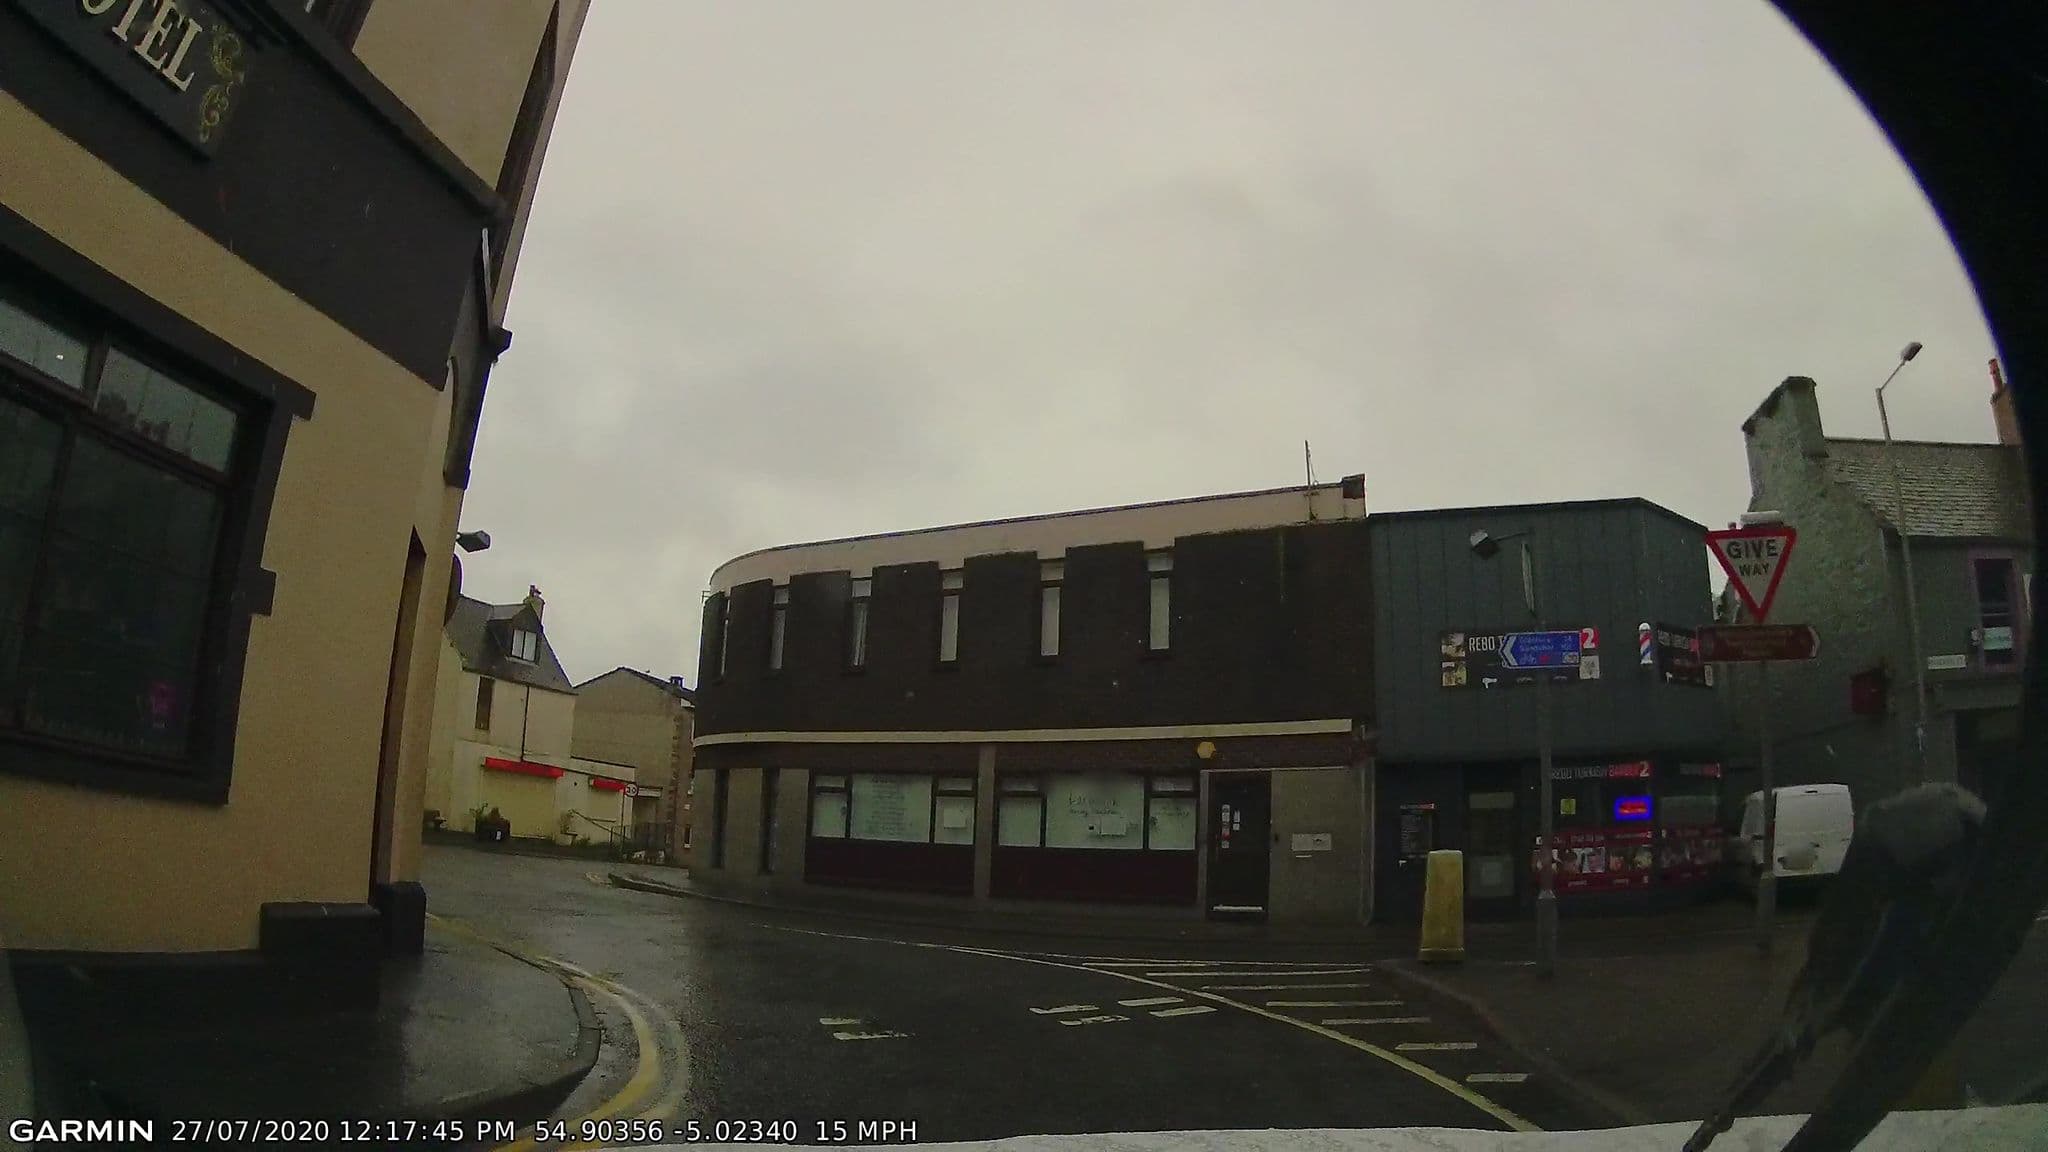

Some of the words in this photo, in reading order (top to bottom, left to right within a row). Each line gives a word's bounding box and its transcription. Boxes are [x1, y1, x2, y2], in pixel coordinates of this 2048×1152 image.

[82, 0, 203, 92] TEL
[1727, 539, 1778, 558] GIVE
[1739, 563, 1769, 577] WAY
[1469, 636, 1495, 652] REBO
[1582, 627, 1596, 649] 2
[1639, 760, 1650, 778] 2
